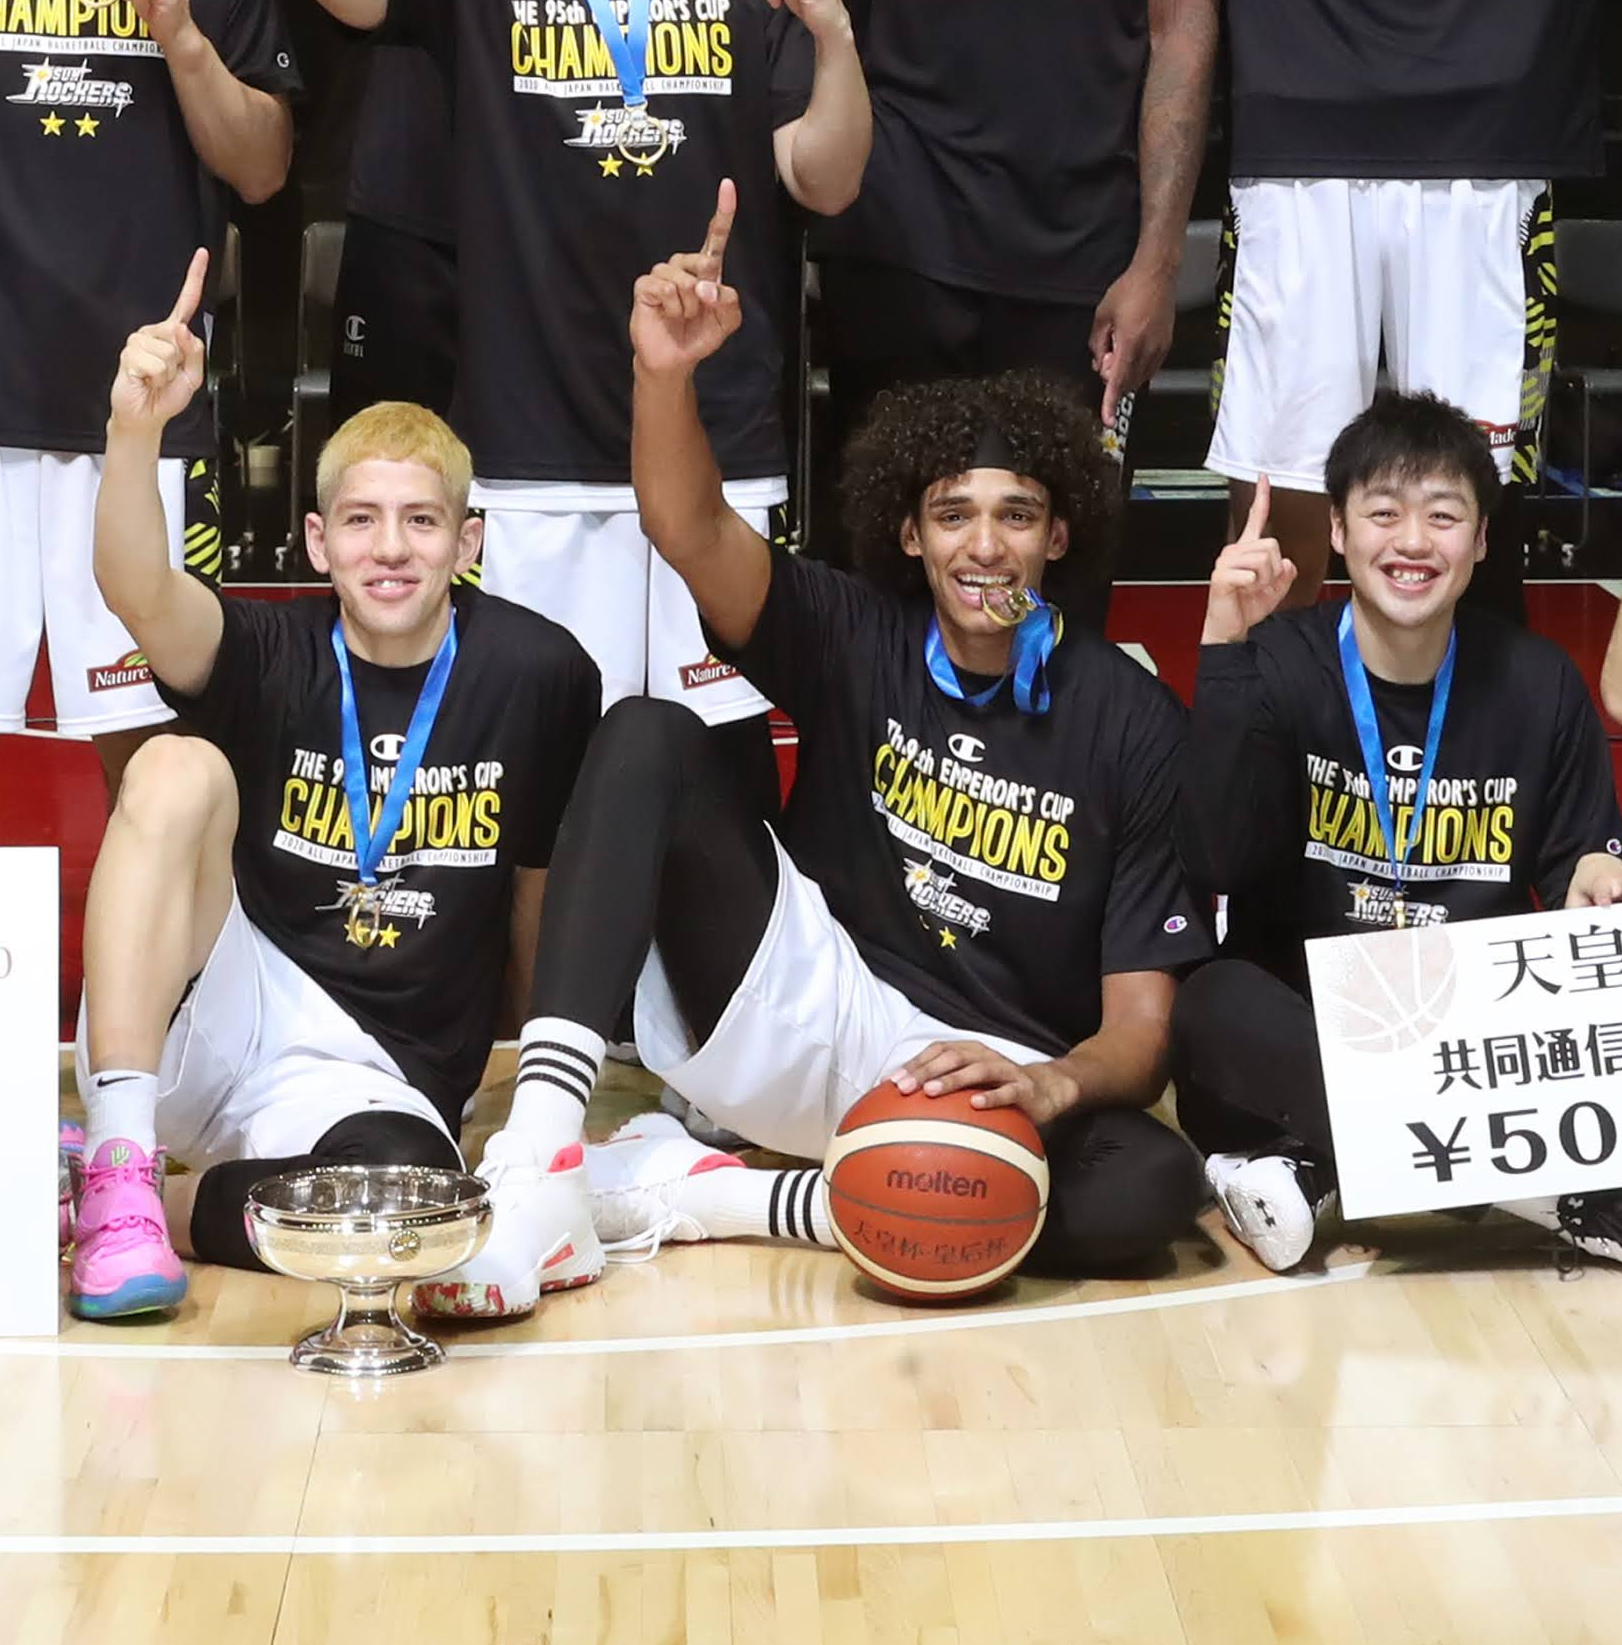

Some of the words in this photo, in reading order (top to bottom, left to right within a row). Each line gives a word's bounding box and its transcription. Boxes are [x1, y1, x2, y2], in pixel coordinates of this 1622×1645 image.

[546, 0, 586, 24] 95th
[12, 37, 41, 50] JAPAN
[48, 38, 107, 51] BASKETBALL
[511, 21, 733, 80] CHAMIONS
[6, 60, 134, 117] ROCKERS
[564, 83, 592, 96] JAPAN
[662, 79, 724, 91] CHAMPIONSHIP
[95, 667, 148, 688] Nature
[687, 664, 731, 685] Nature
[291, 748, 327, 781] THE
[1307, 753, 1339, 787] THE
[1484, 777, 1517, 805] CUP
[939, 758, 1035, 814] EMPEROR'S
[1041, 790, 1074, 824] CUP
[874, 743, 1070, 883] CHAMPIONS
[979, 864, 1052, 896] CHAMPIONSHIP
[1435, 865, 1504, 878] CHAMPIONSHIP
[886, 1169, 988, 1199] molten
